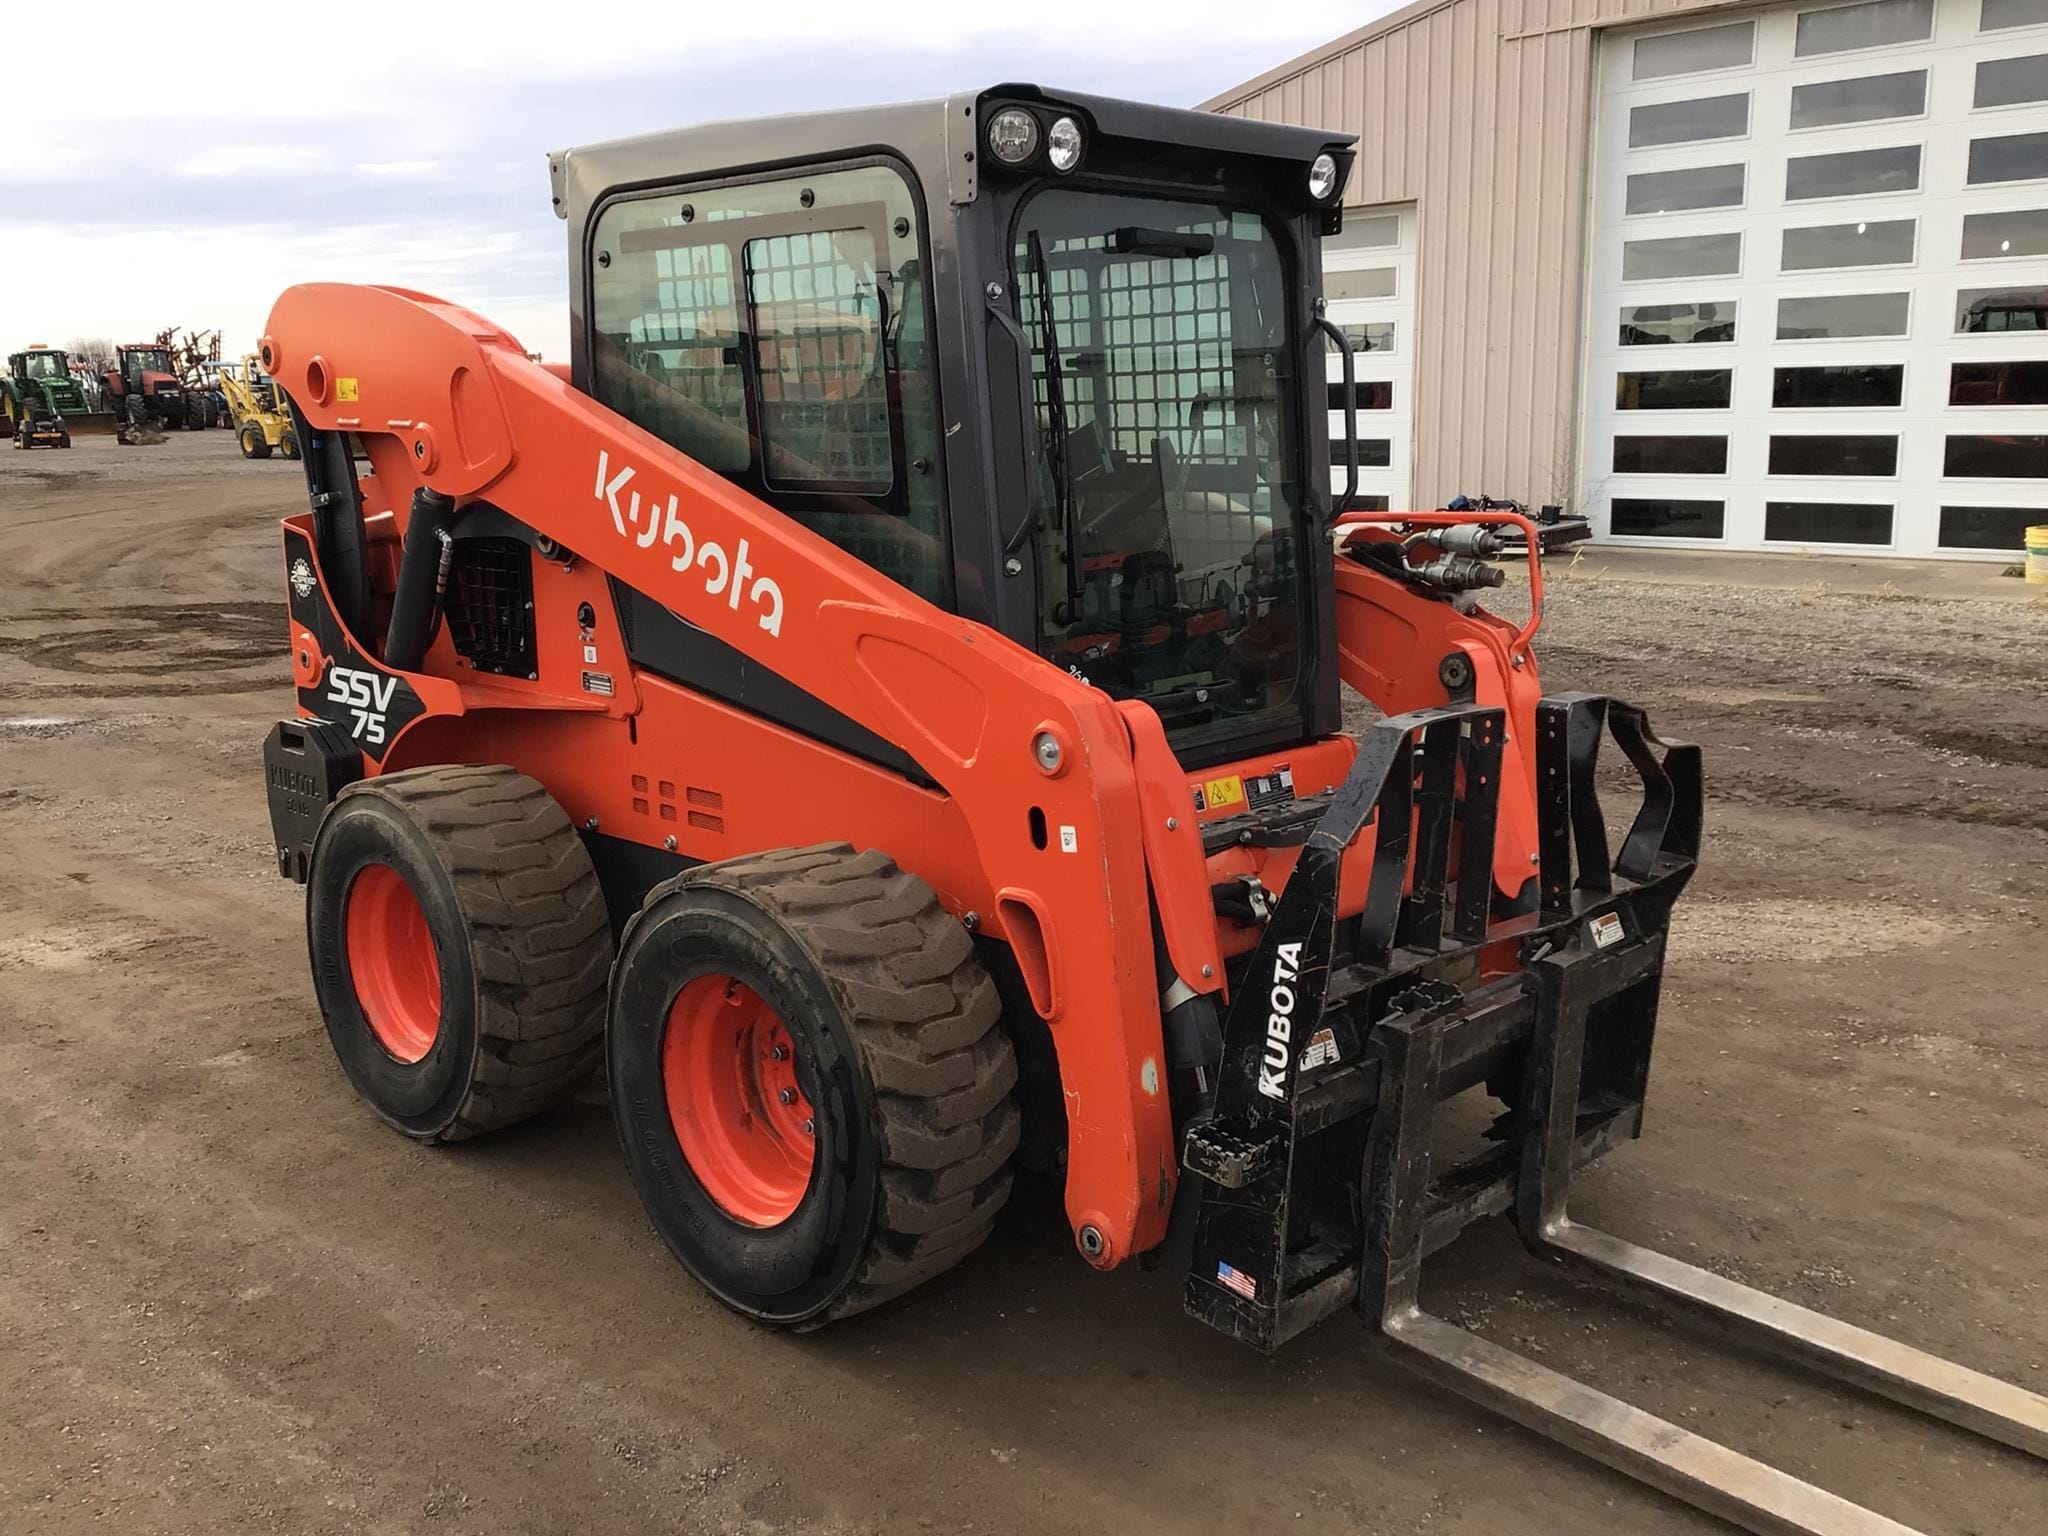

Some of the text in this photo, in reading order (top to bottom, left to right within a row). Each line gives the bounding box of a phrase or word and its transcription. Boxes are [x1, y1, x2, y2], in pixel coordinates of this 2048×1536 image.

[594, 449, 784, 638] Kubota
[327, 666, 397, 712] SSV
[350, 708, 386, 745] 75
[270, 763, 322, 801] KUBOTA
[1258, 942, 1303, 1103] KUBOTA
